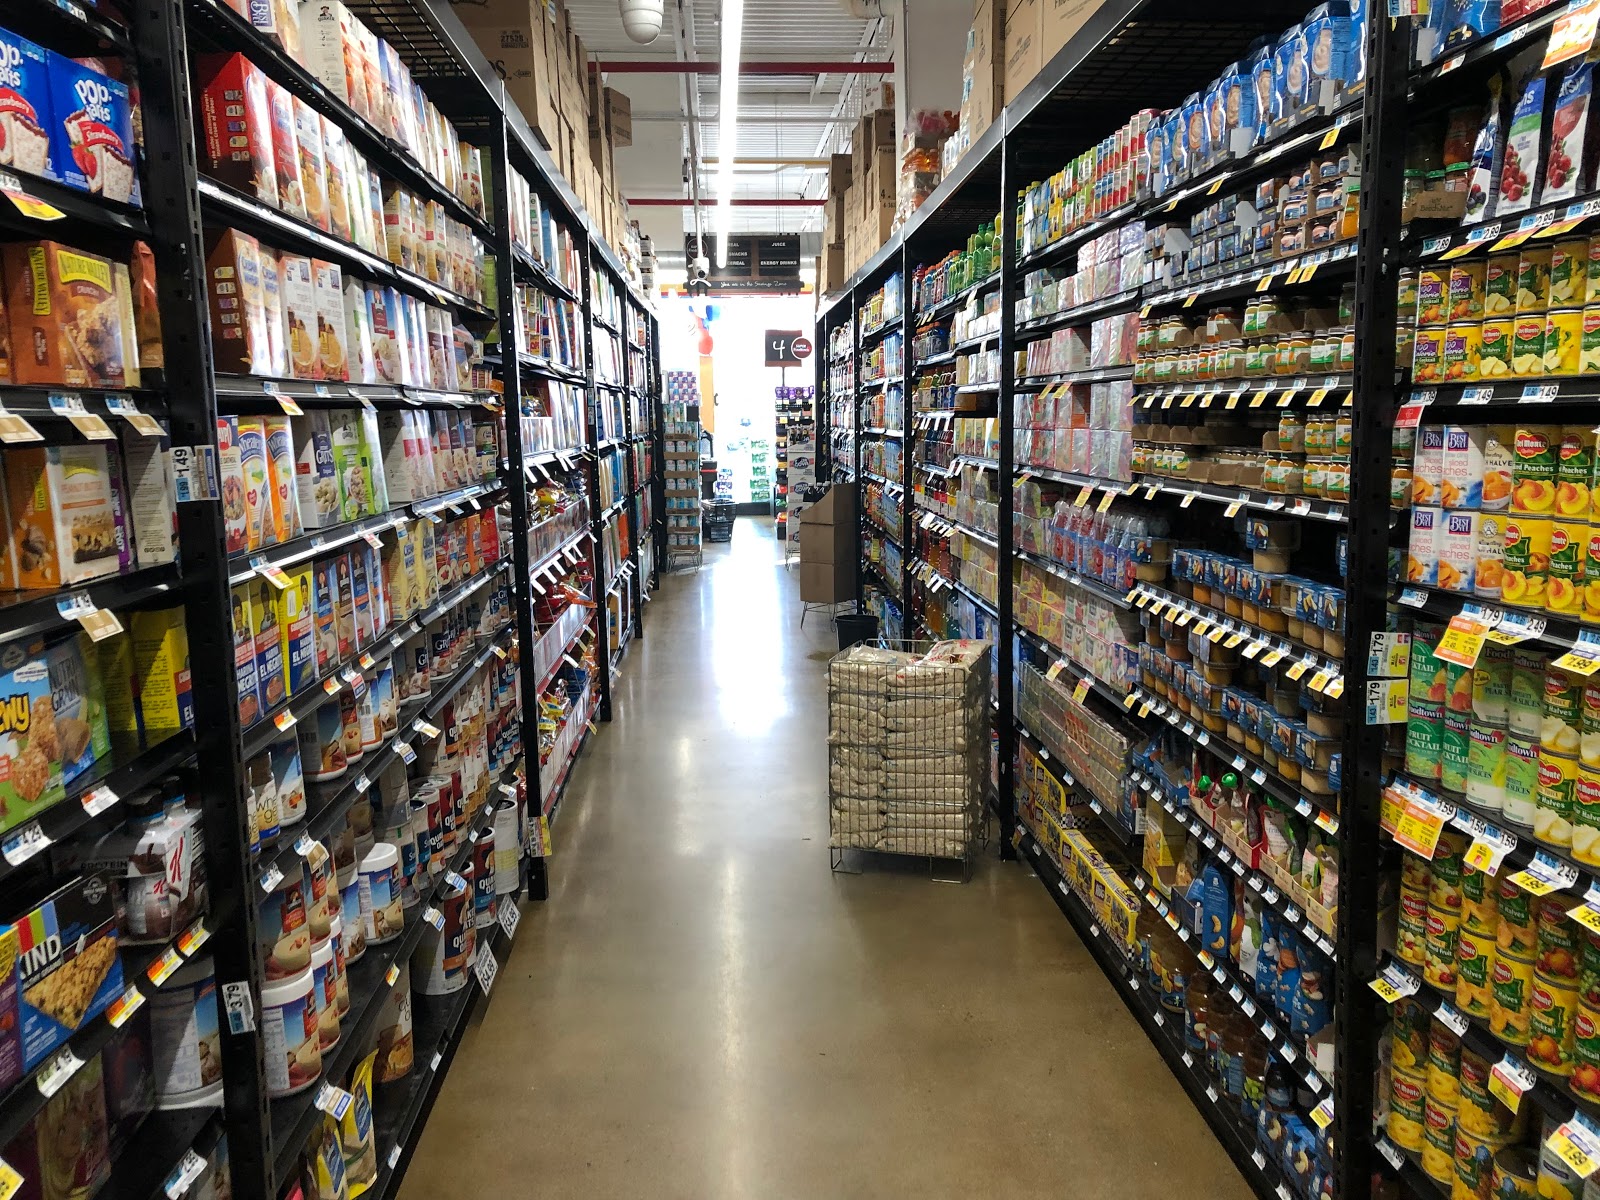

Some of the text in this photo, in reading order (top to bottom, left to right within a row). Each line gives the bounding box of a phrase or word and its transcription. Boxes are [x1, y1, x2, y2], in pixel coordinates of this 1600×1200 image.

[86, 130, 119, 145] Strawberry
[773, 340, 785, 359] 4
[1449, 433, 1468, 448] BEST
[1525, 440, 1547, 449] Monte
[1449, 459, 1468, 467] sliced
[1524, 464, 1554, 473] Peaches
[1415, 511, 1433, 526] BEST
[1450, 515, 1470, 531] BEST
[1551, 561, 1573, 570] Peaches
[1548, 708, 1573, 720] Halves
[1541, 797, 1567, 809] Halves
